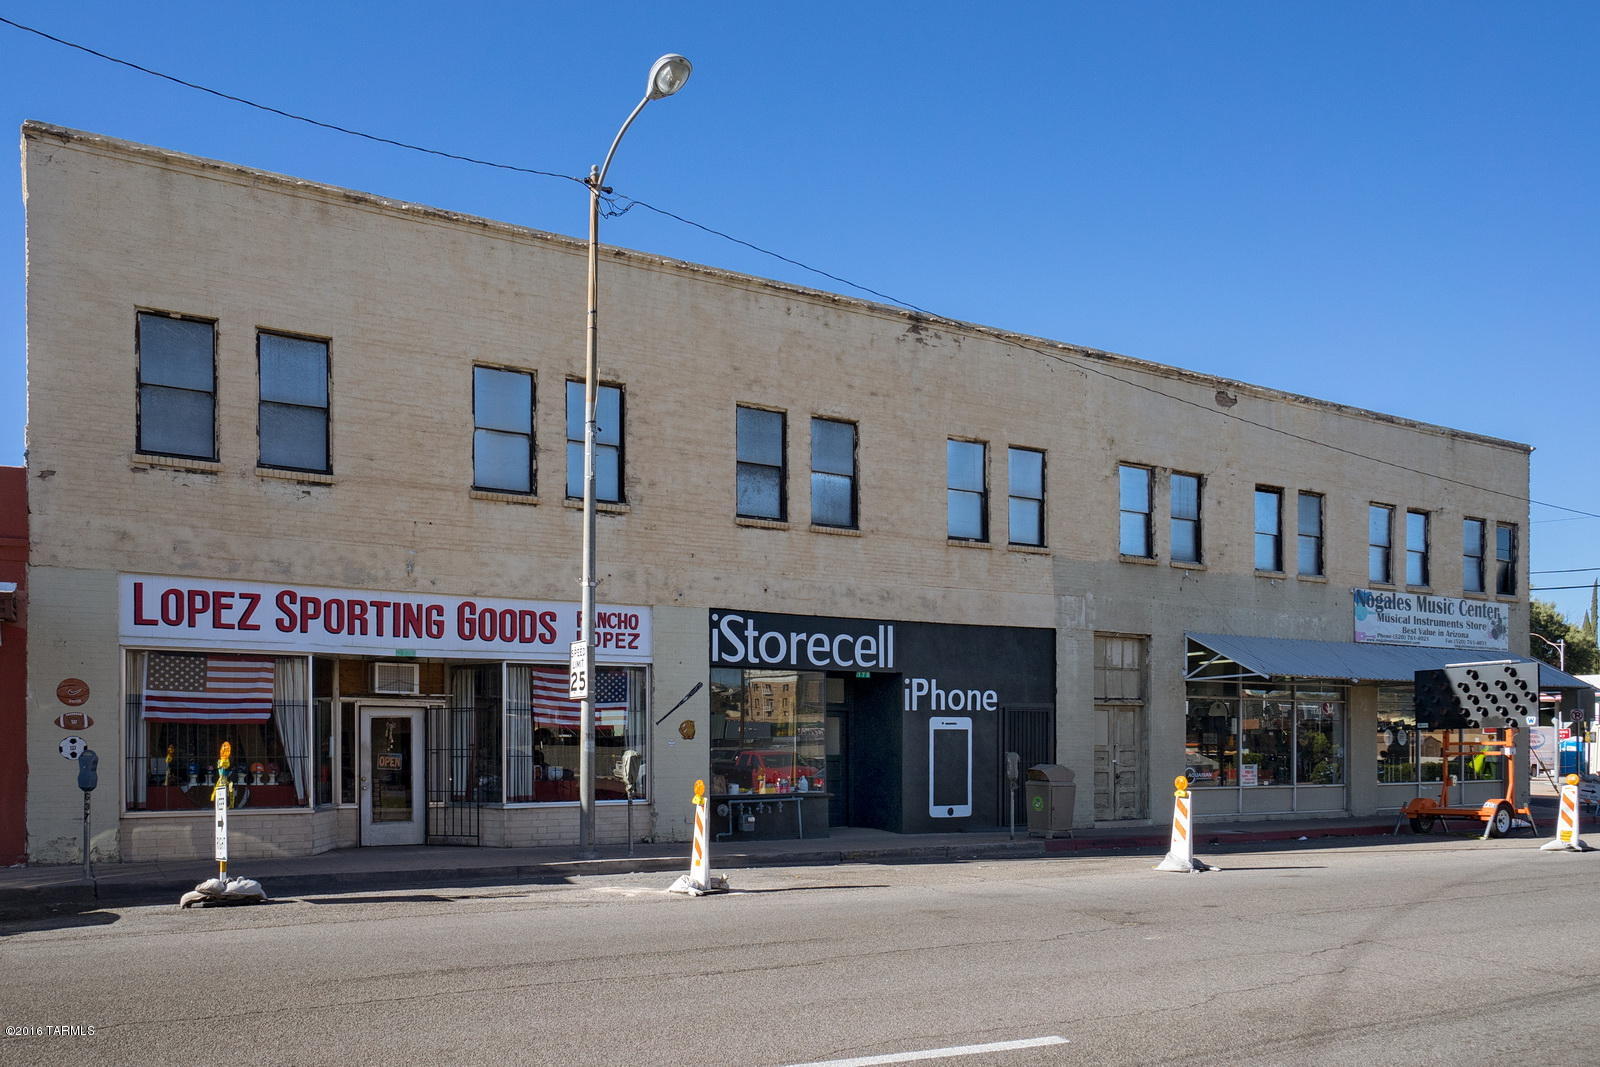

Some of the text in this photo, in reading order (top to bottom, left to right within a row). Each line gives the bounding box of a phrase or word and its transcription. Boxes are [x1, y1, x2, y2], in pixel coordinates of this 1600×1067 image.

[133, 581, 557, 645] LOPEZ SPORTING GOODS
[1355, 589, 1500, 619] Nogales Music Center
[1376, 613, 1487, 631] Musical Instruments Store
[711, 613, 894, 668] iStorecell
[1402, 626, 1470, 638] Best Value in Arizona
[570, 647, 586, 657] SPEED
[572, 659, 584, 669] LIMIT
[571, 671, 586, 692] 25
[904, 678, 998, 711] iPhone
[379, 756, 400, 768] OPEN
